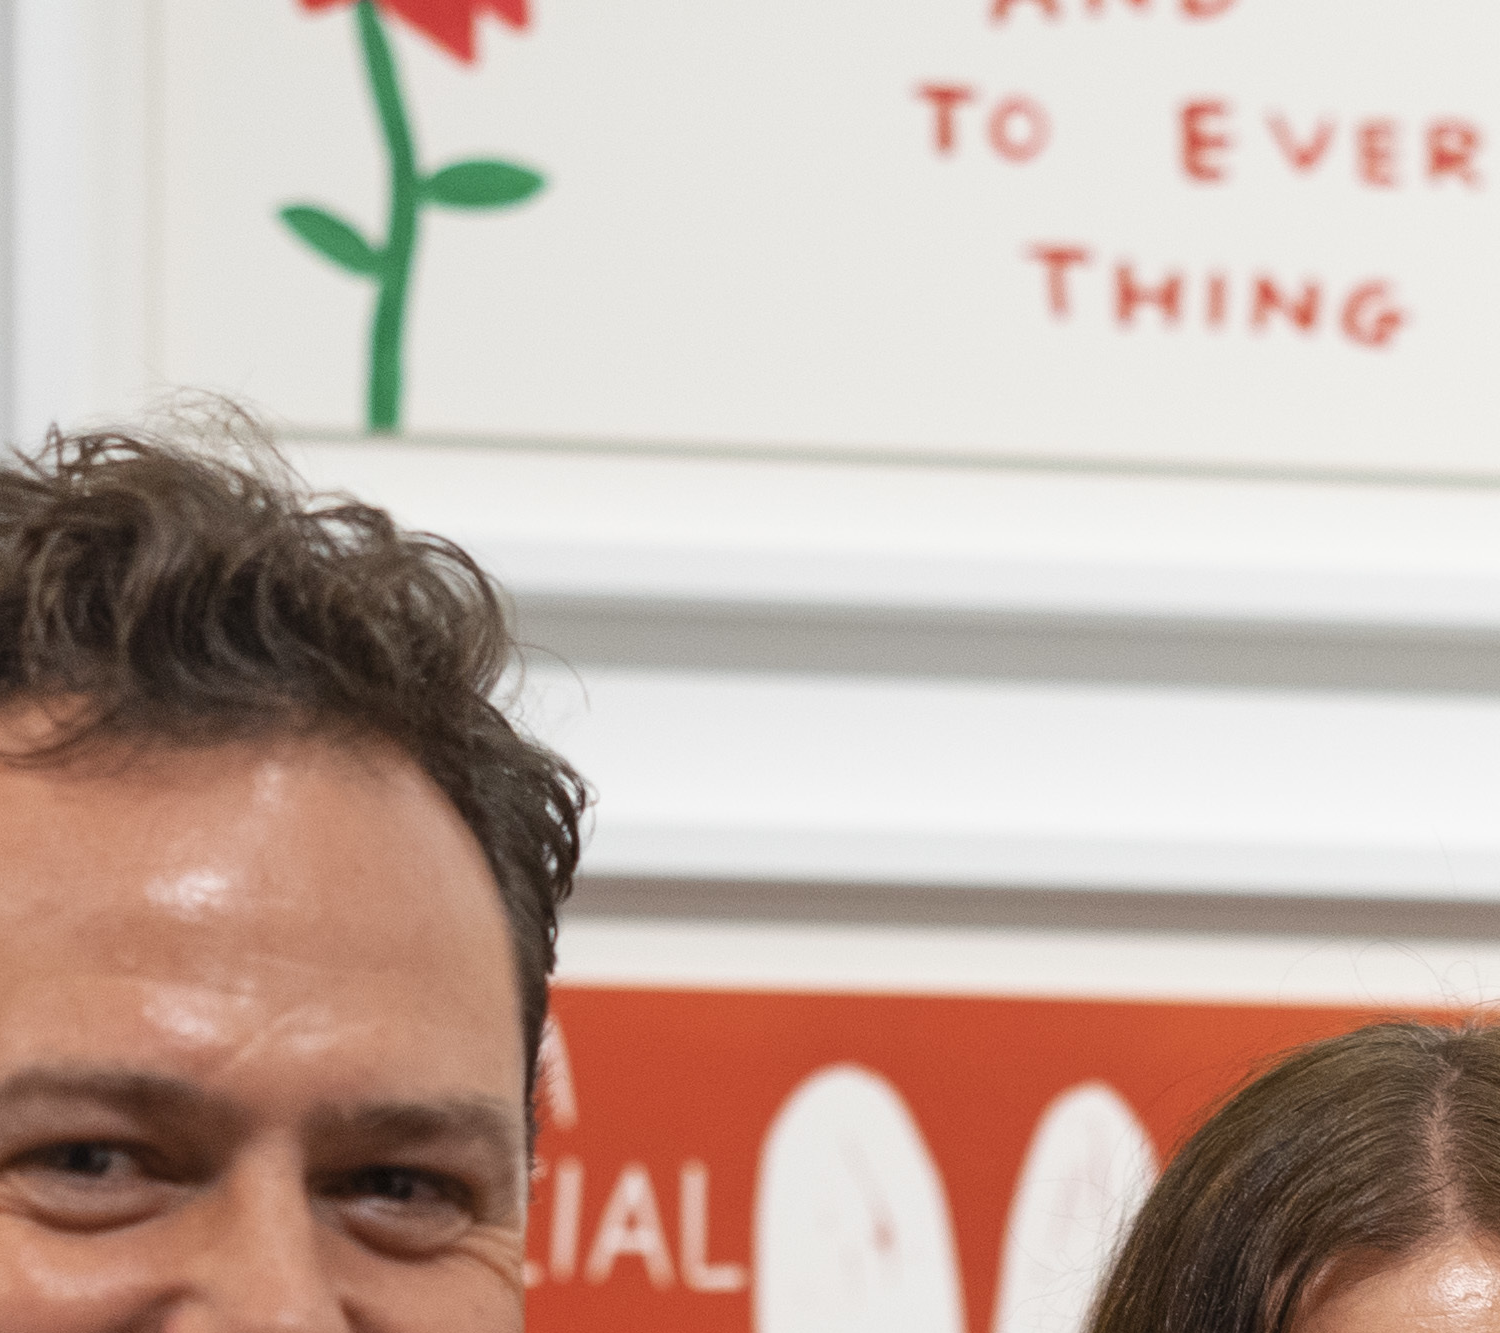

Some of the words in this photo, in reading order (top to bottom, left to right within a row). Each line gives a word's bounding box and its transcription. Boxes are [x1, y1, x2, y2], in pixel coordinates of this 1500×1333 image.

[913, 80, 1050, 165] TO
[1027, 241, 1408, 351] THING
[524, 1155, 748, 1291] IAL
